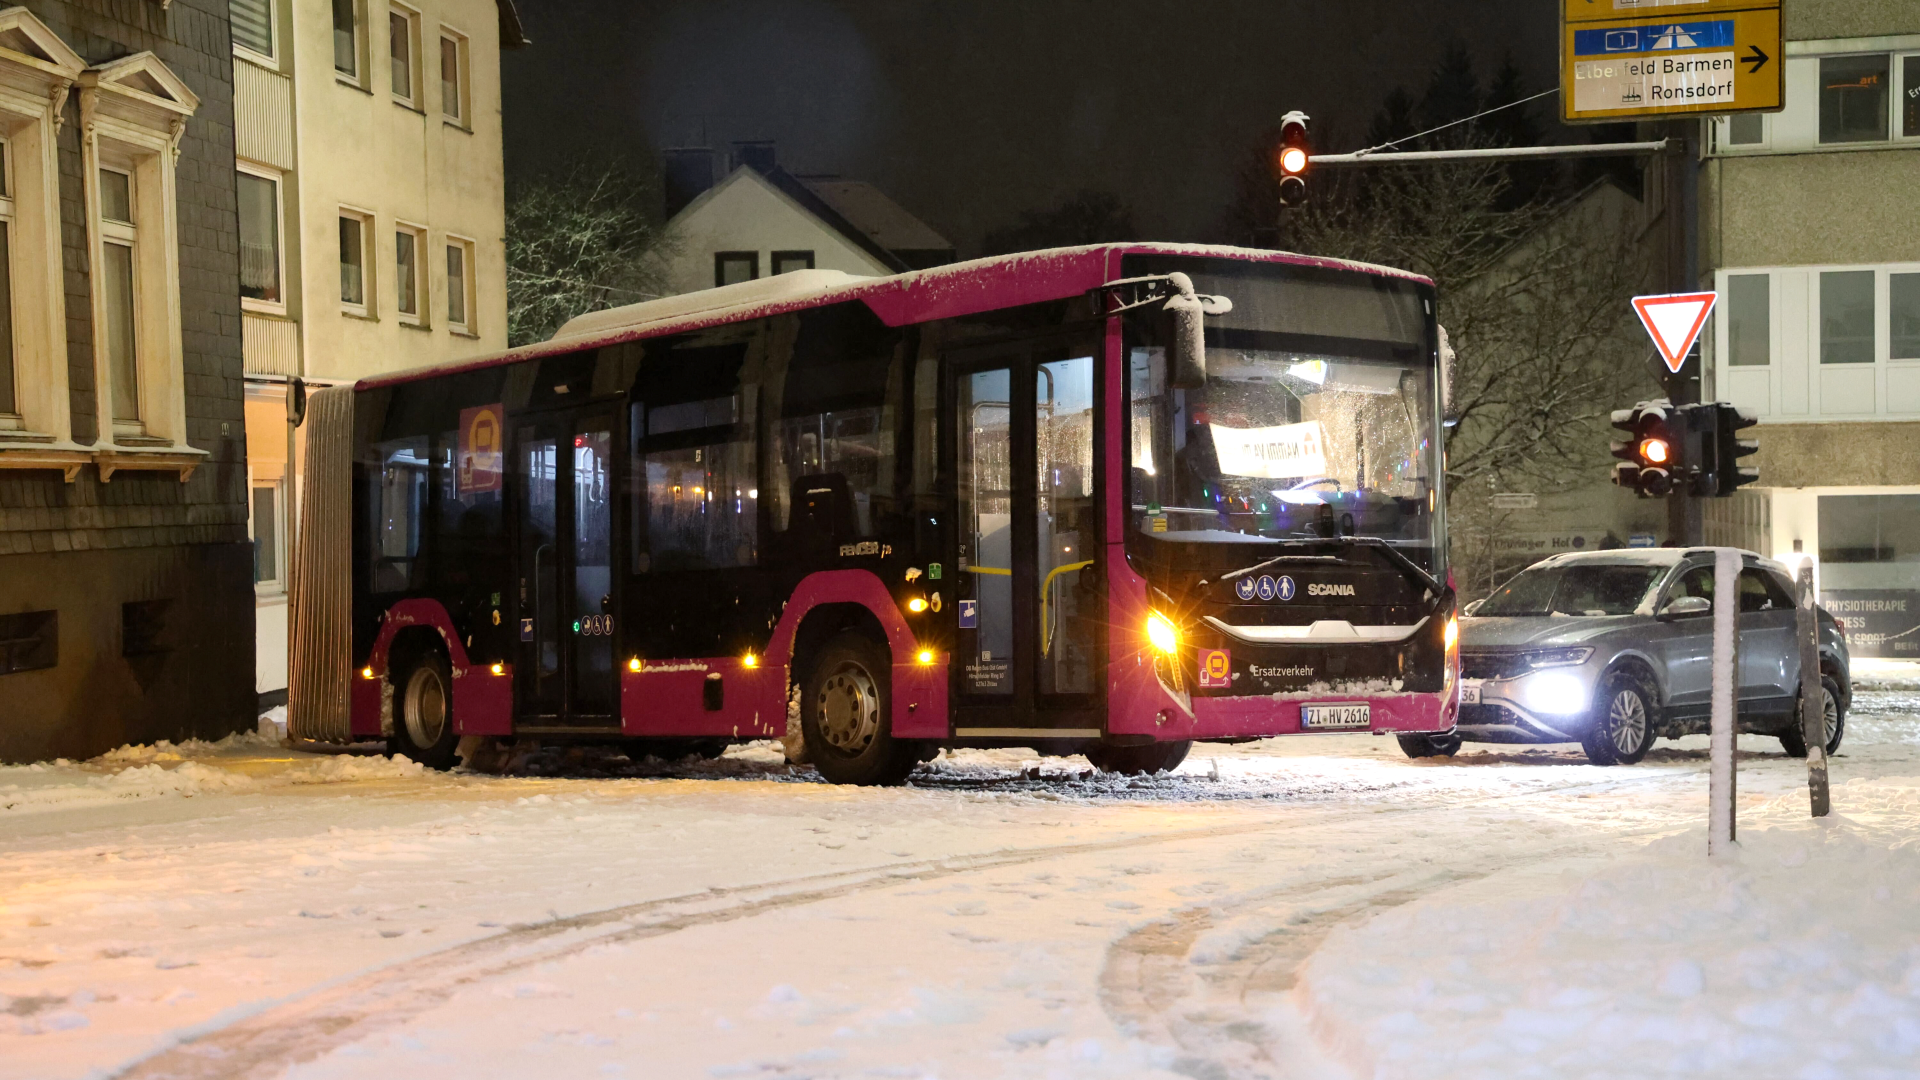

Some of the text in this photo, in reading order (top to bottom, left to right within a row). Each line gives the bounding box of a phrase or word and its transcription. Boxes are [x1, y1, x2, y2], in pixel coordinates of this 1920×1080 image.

[1619, 34, 1625, 46] 1
[1575, 58, 1733, 80] Elberfeld Barmen
[1651, 81, 1733, 100] Ronsdorf
[1552, 537, 1570, 548] Hof
[1307, 583, 1355, 596] SCANIA
[1825, 600, 1906, 612] PHYSIOTHERAPIE
[1854, 633, 1886, 645] SPORT
[1252, 664, 1314, 677] Ersatzverkehr
[1309, 707, 1369, 724] ZI HV 2616
